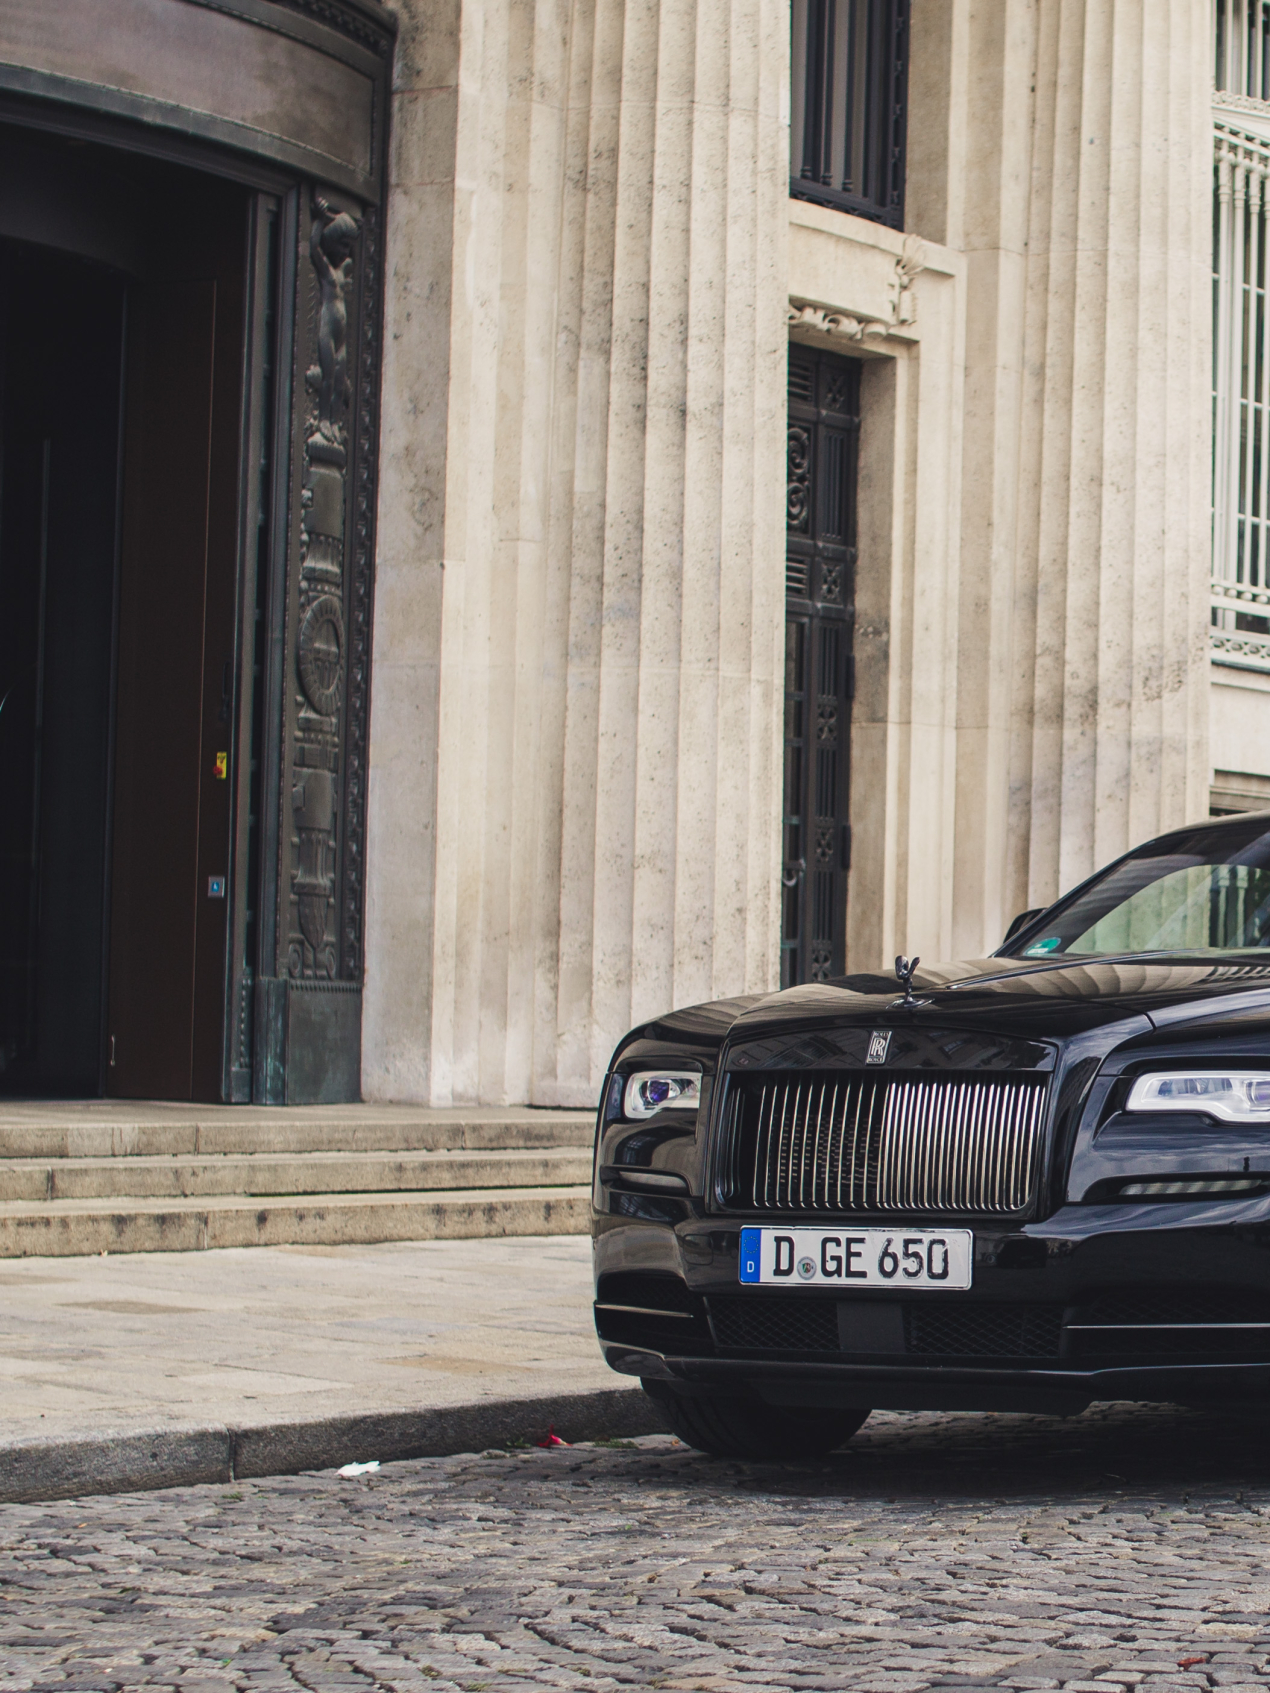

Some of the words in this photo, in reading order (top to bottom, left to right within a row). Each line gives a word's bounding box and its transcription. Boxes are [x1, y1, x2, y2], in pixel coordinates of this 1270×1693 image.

[746, 1261, 755, 1273] D
[773, 1235, 795, 1277] D
[820, 1236, 868, 1279] GE
[877, 1237, 949, 1280] 650
